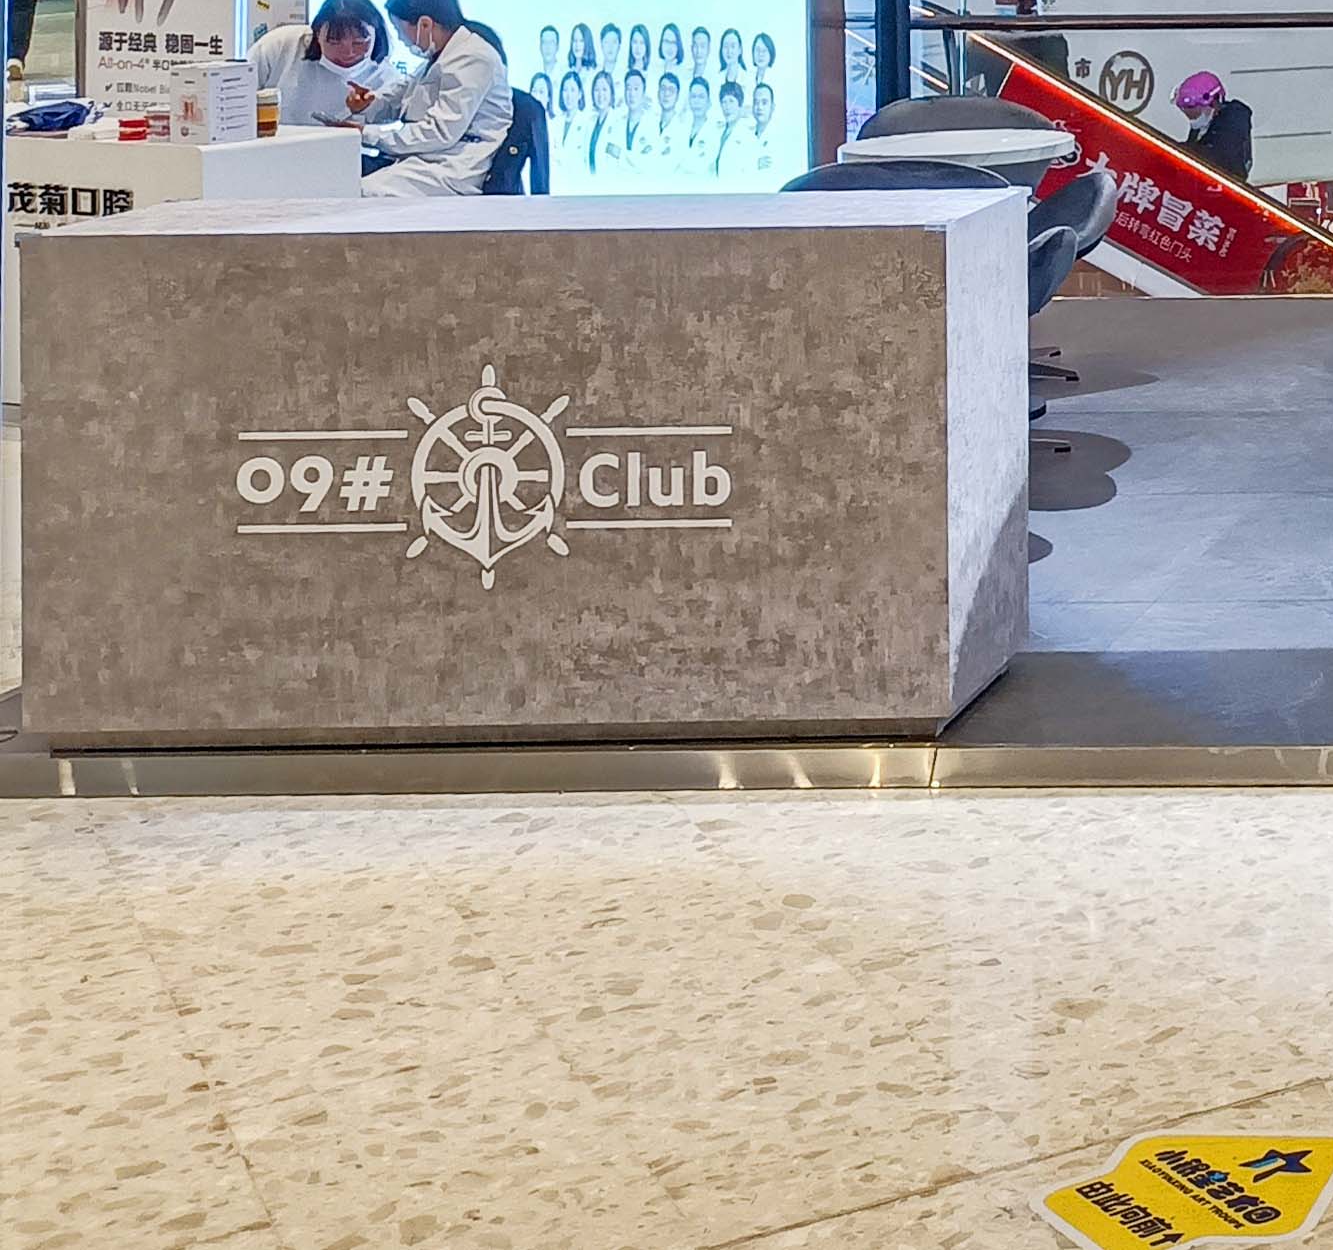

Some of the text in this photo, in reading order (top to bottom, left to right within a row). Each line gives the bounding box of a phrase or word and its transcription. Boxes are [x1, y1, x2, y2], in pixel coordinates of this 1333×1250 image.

[99, 31, 223, 55] 源于经典 稳固一生
[1075, 58, 1092, 79] 市
[7, 182, 134, 217] 茂菊口腔
[236, 452, 394, 515] 09#
[579, 451, 732, 509] Club
